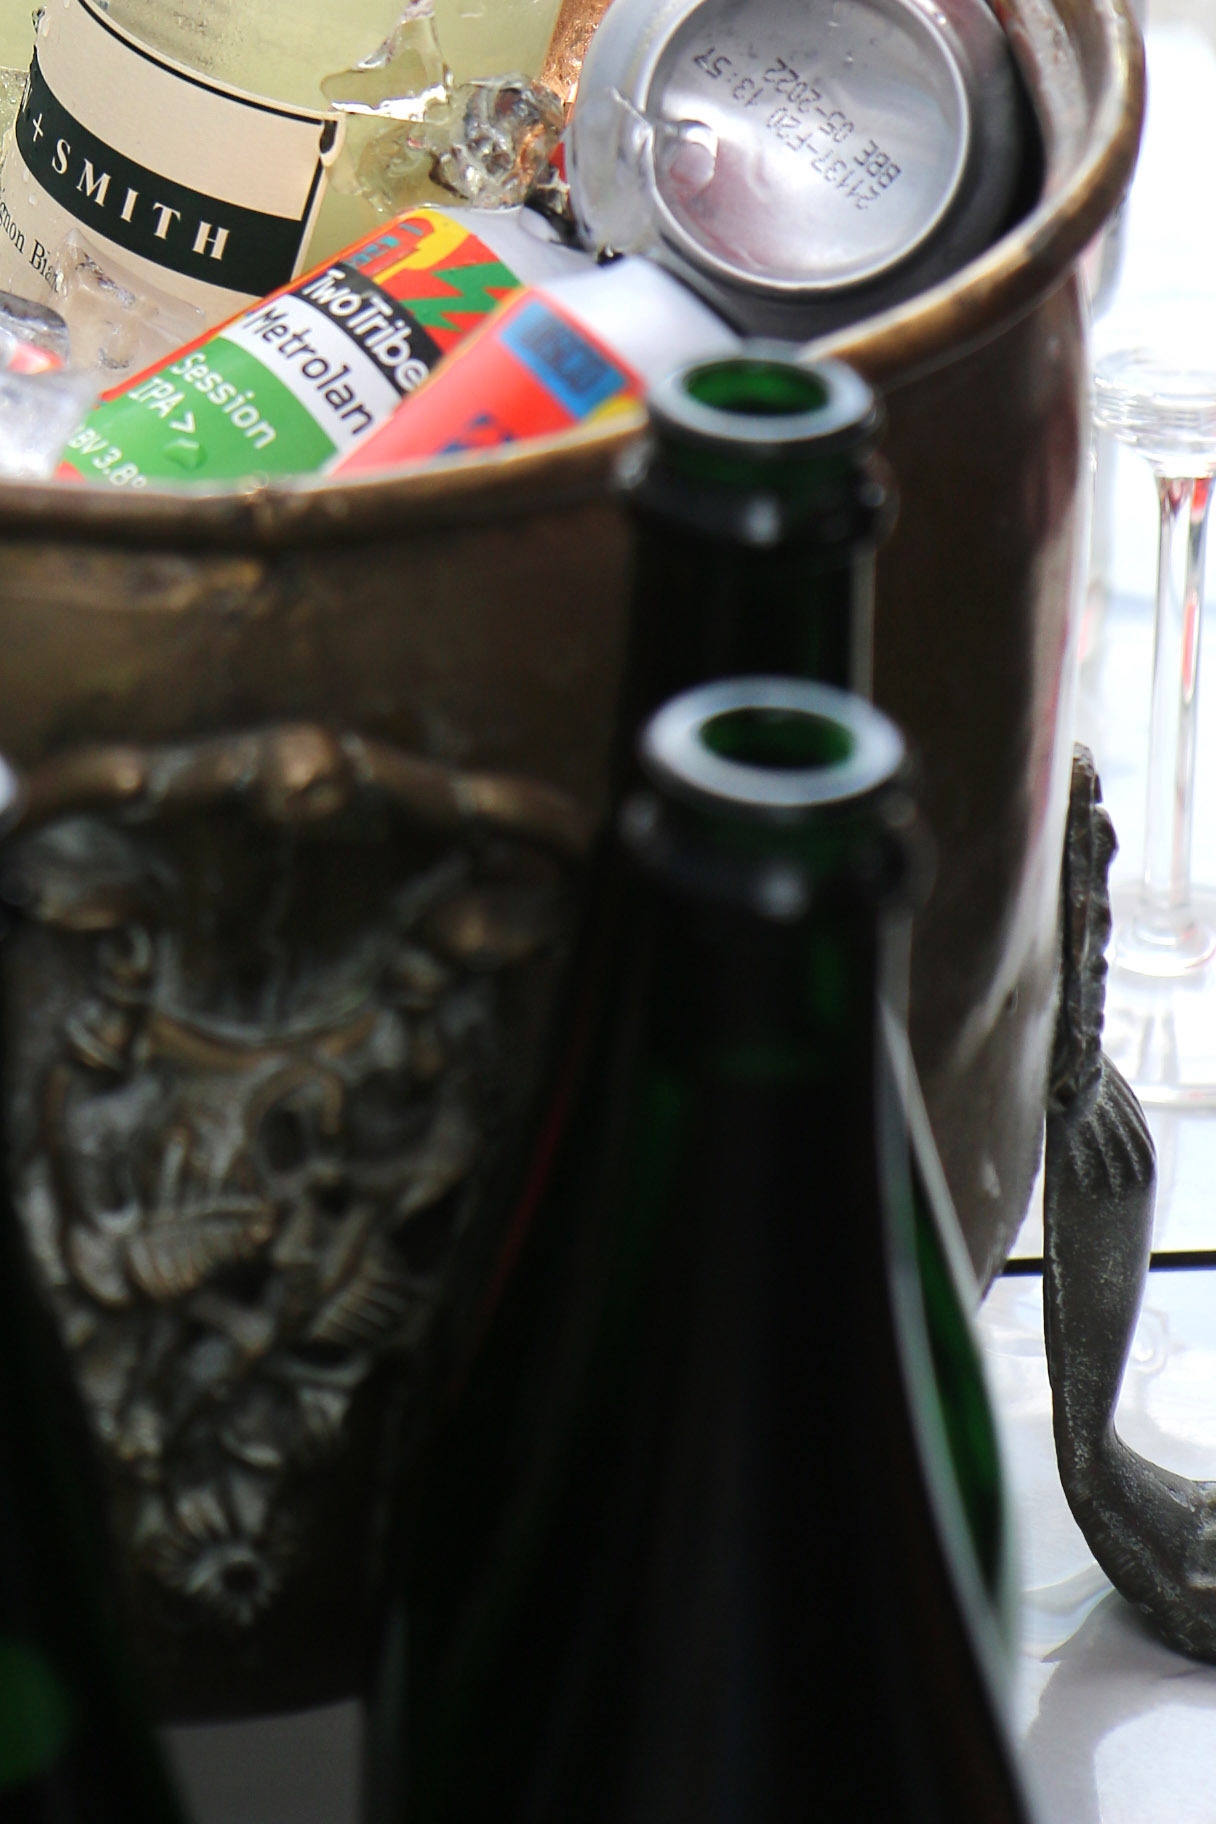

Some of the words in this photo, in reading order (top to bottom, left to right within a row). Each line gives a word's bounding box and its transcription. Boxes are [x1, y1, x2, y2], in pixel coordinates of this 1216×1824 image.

[692, 46, 766, 108] 13:57
[761, 57, 855, 143] 05-2022
[51, 138, 230, 261] SMITH
[851, 139, 902, 190] BBE
[128, 376, 185, 419] IPA
[170, 351, 277, 450] Session
[242, 306, 374, 436] Metrolan
[67, 425, 109, 455] BV
